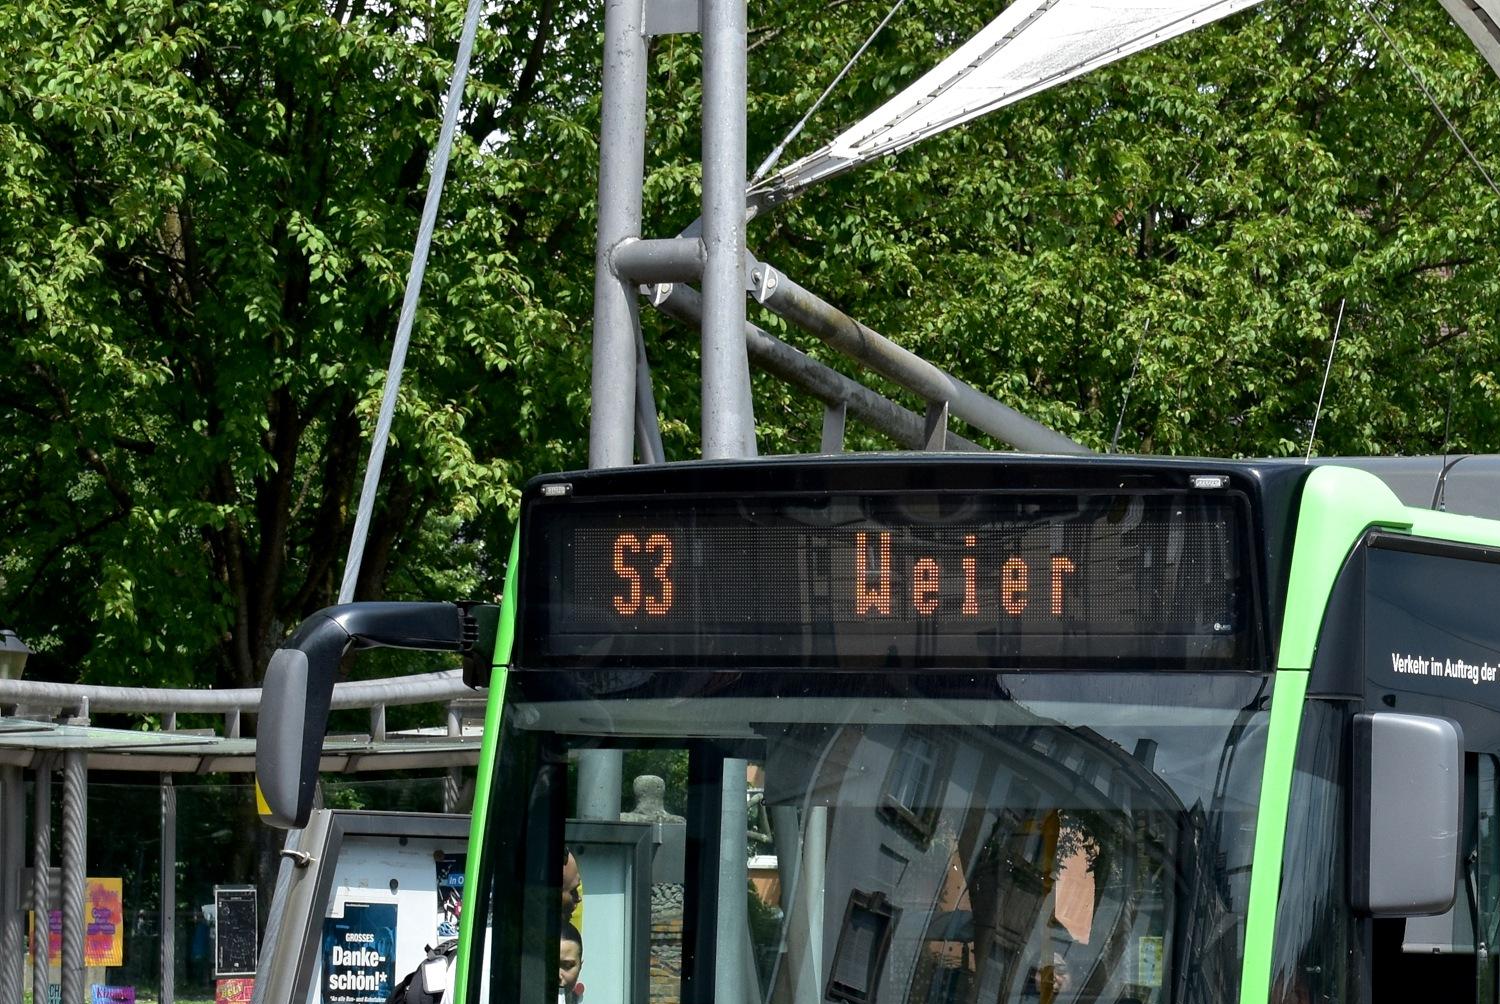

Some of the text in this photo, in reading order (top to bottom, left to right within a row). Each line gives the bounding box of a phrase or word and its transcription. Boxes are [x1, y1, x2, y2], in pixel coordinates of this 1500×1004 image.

[613, 533, 1075, 616] S3 Weier
[1391, 653, 1429, 675] Verkehr
[1431, 657, 1442, 676] im
[1444, 658, 1479, 685] Auftrag
[1481, 662, 1496, 682] der
[345, 932, 375, 943] GROSSES
[332, 945, 386, 967] Danke-
